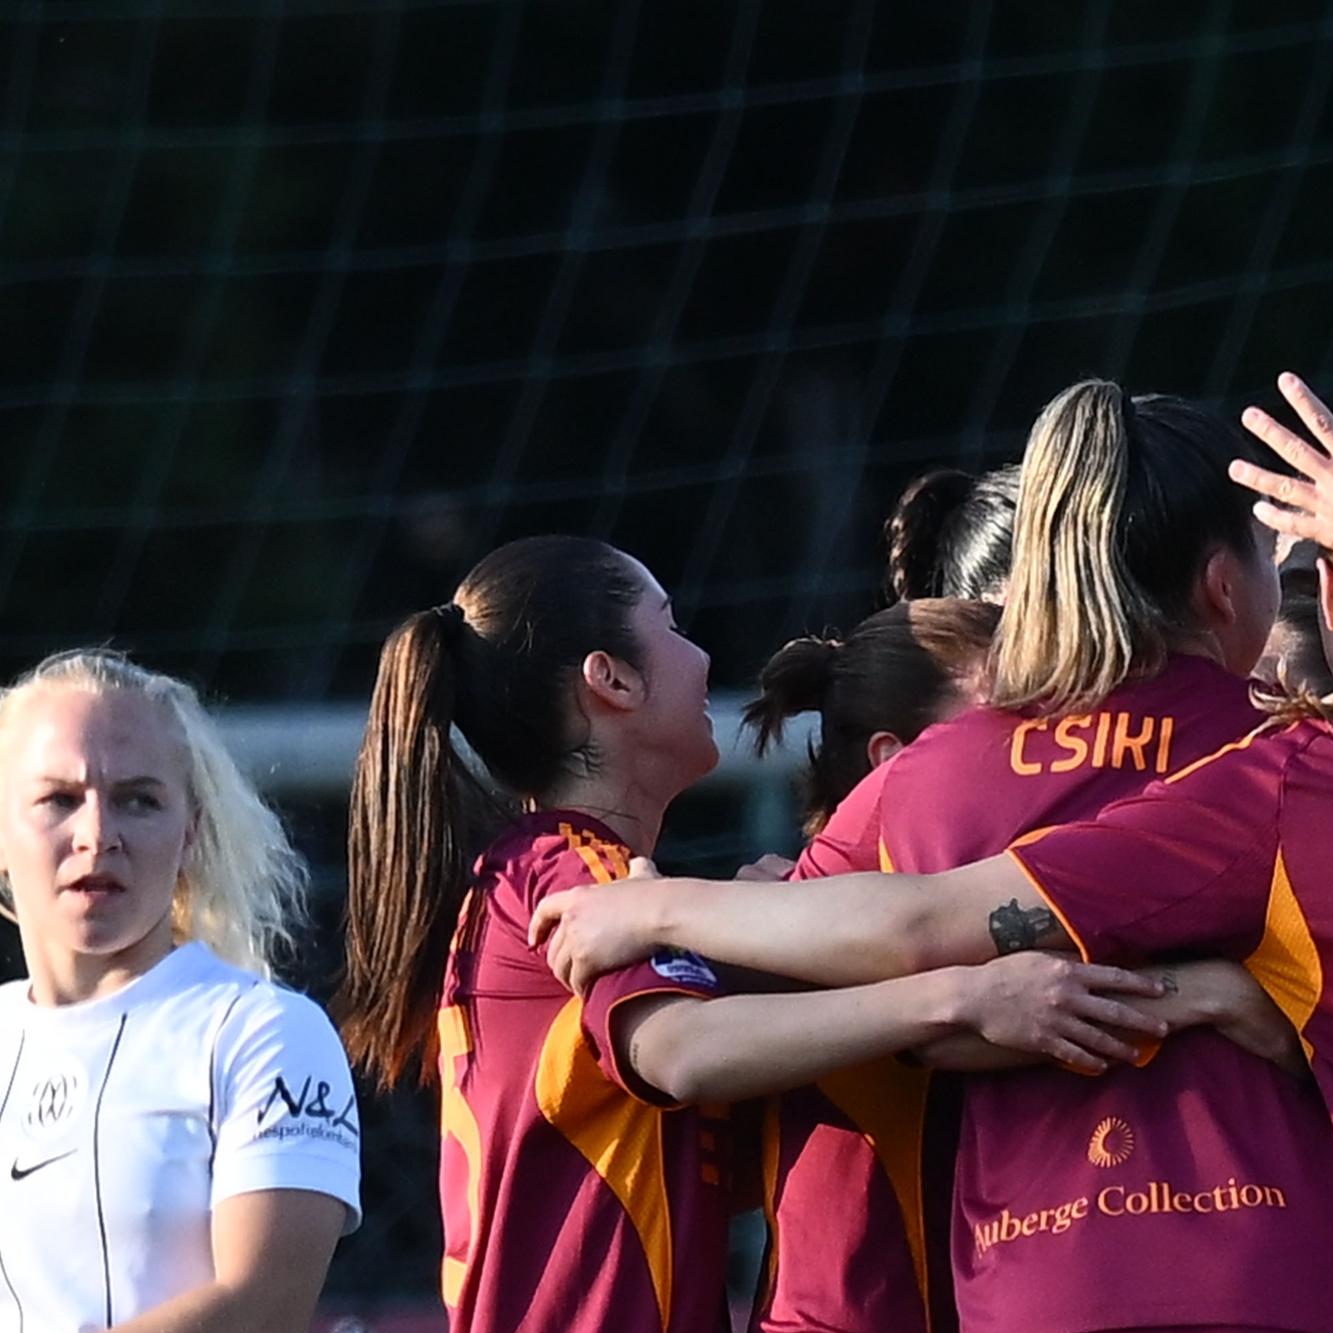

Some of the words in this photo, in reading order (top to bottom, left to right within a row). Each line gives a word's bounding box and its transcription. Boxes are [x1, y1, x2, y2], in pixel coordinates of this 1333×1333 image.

[1010, 712, 1173, 775] CSIKI
[973, 1195, 1089, 1259] Auberge
[1097, 1177, 1287, 1217] Collection
